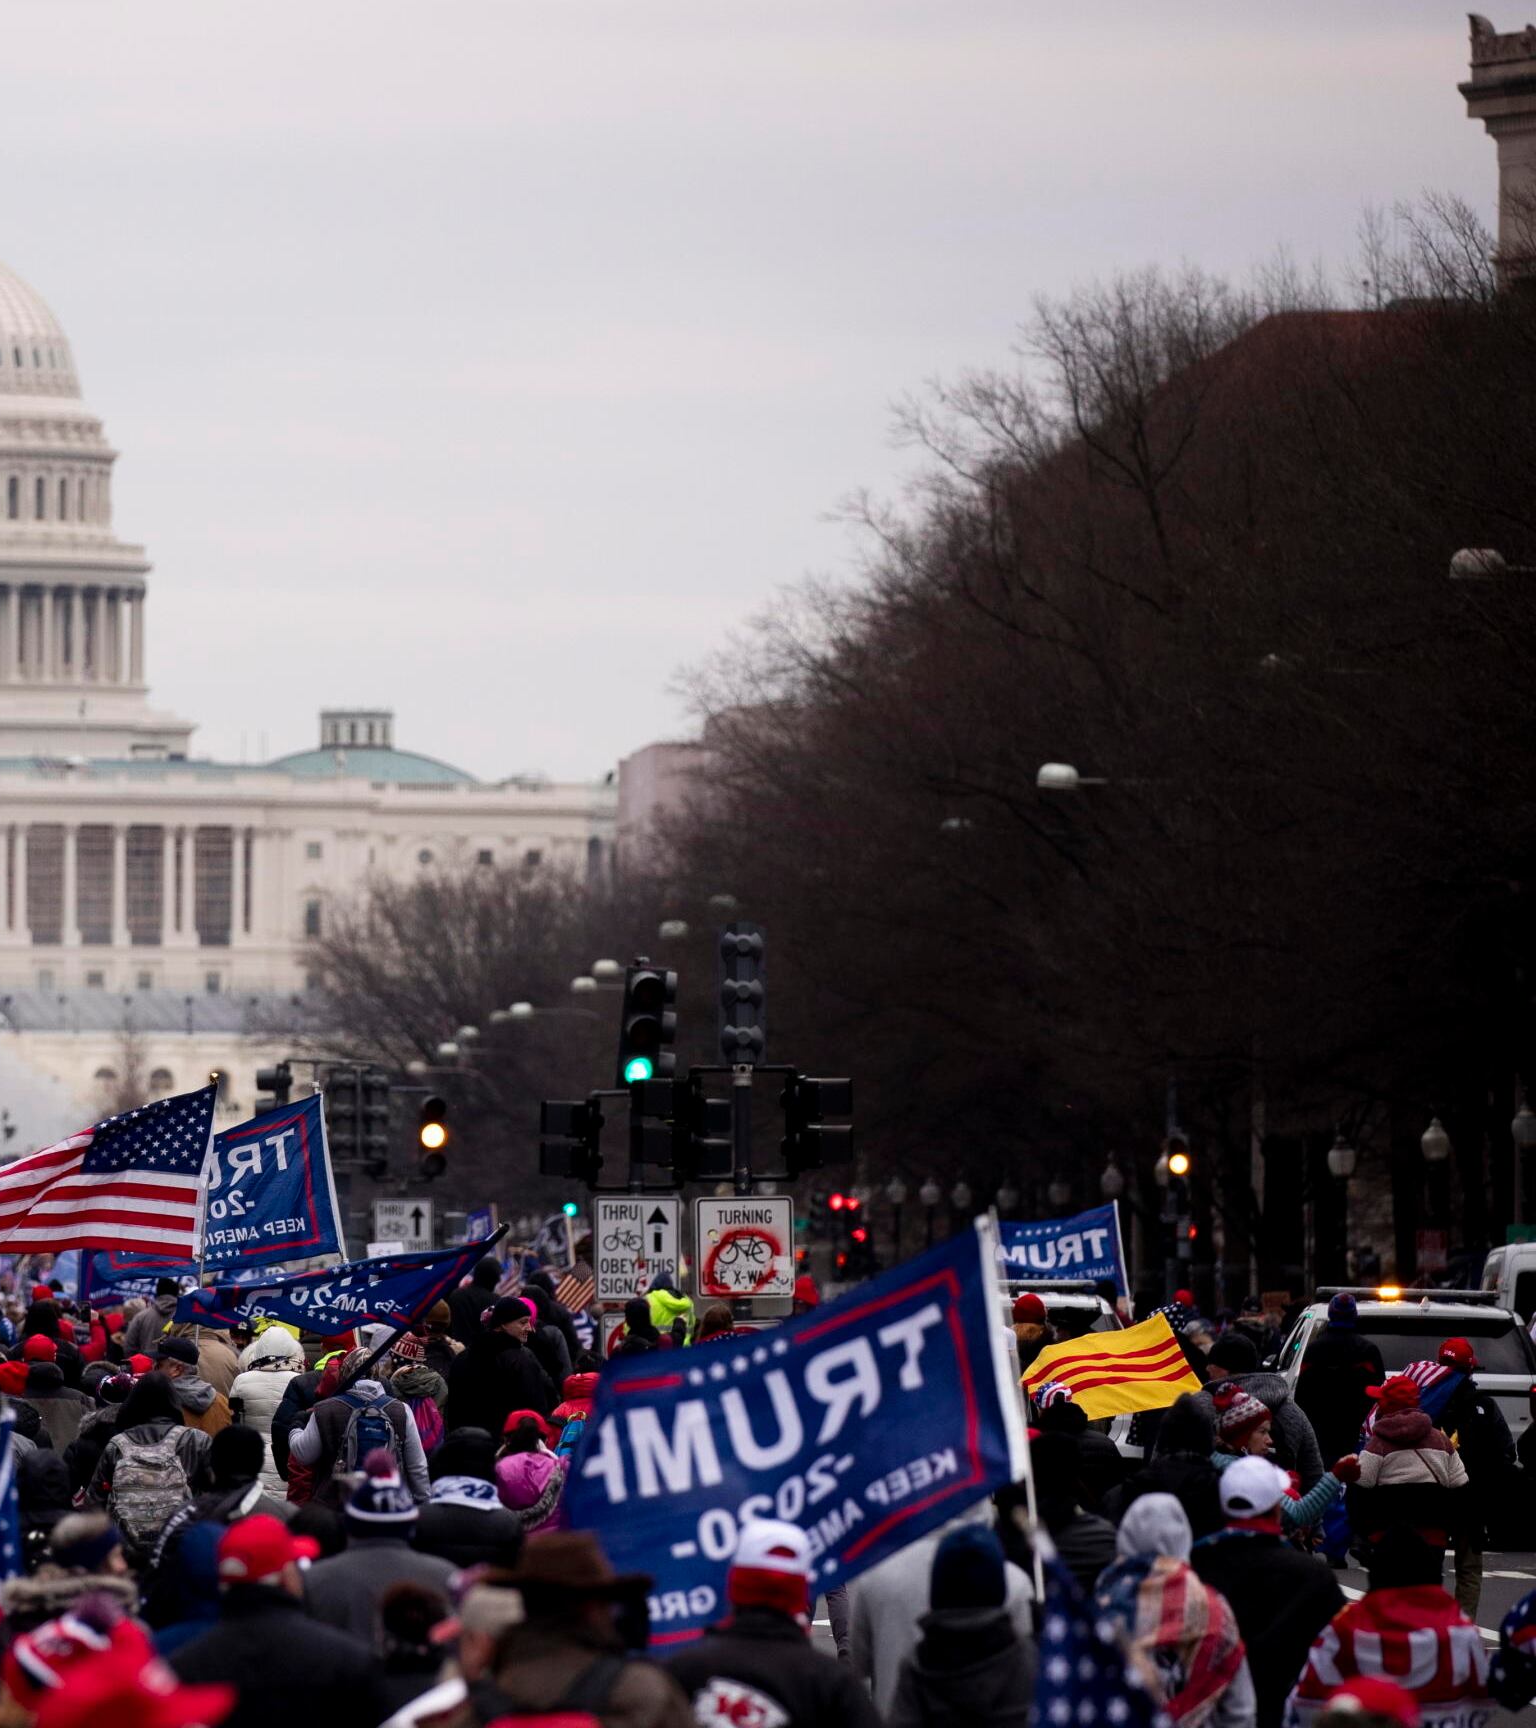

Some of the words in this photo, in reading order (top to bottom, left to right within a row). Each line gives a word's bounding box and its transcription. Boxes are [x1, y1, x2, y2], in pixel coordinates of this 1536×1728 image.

[602, 1204, 638, 1221] THRU
[717, 1209, 773, 1224] TURNING
[600, 1258, 638, 1273] OBEY
[644, 1258, 675, 1273] THIS
